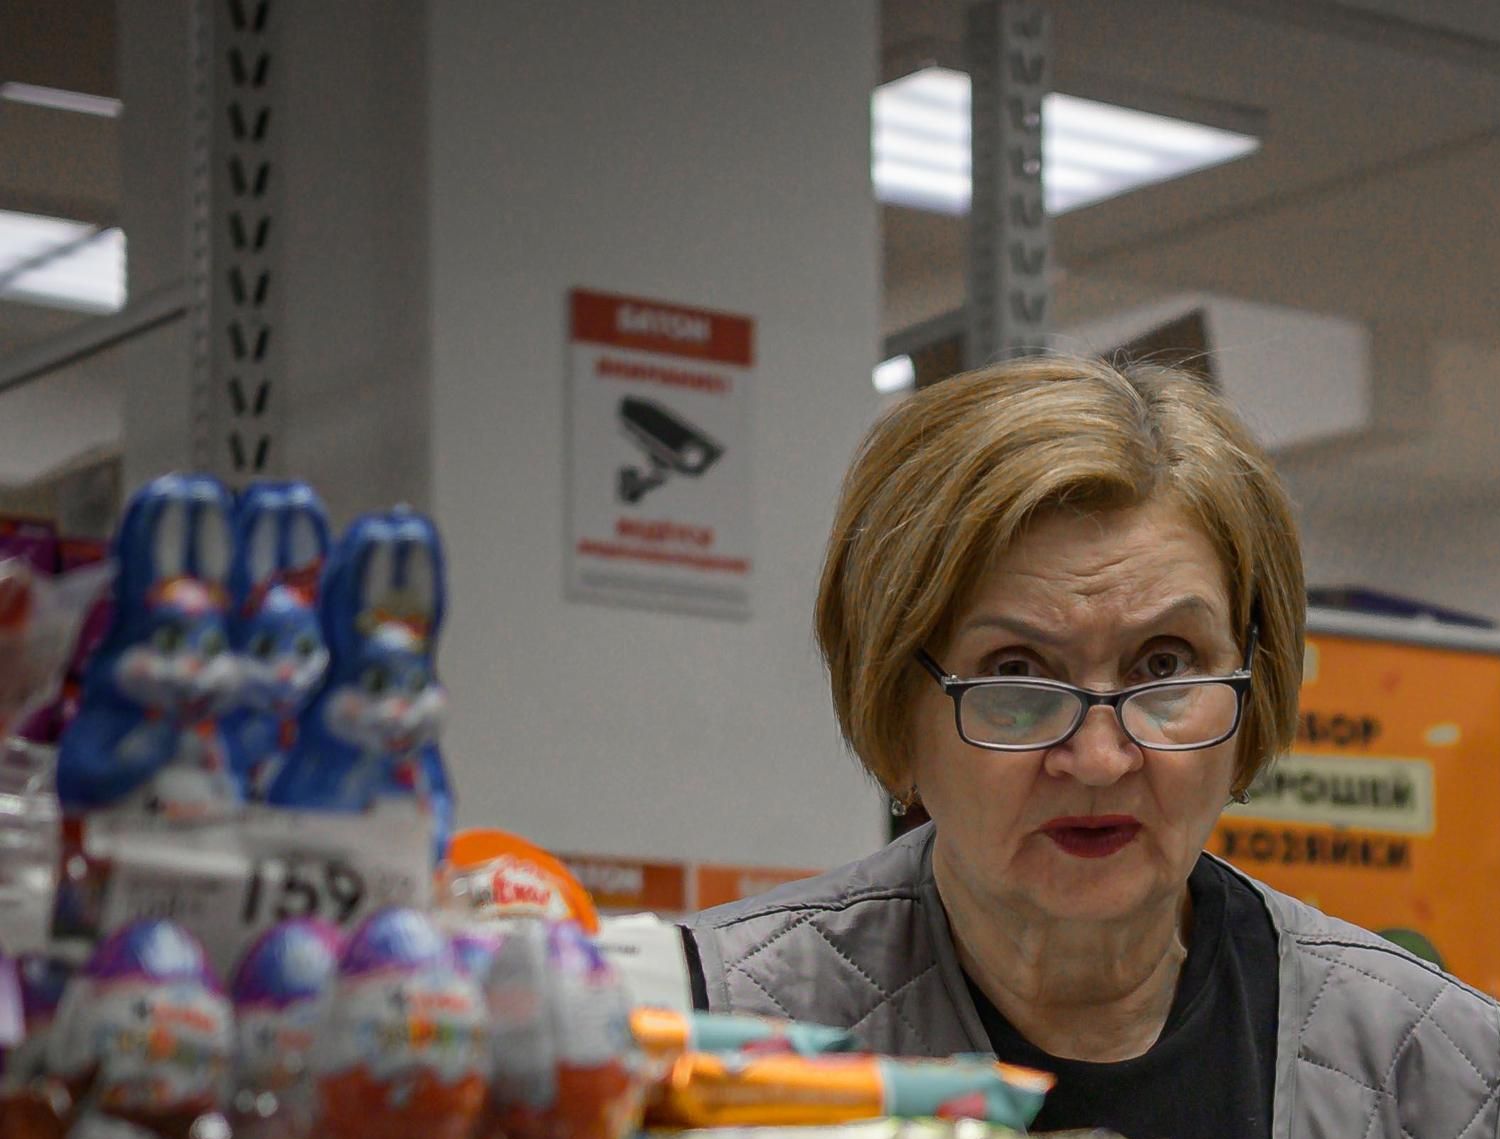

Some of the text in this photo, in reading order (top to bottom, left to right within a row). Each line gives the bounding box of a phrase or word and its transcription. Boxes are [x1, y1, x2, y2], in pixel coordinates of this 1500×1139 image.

[1303, 712, 1380, 745] БОР
[1248, 766, 1414, 812] ОРОШЕЙ
[1220, 826, 1411, 871] ХОЗЯЙКИ
